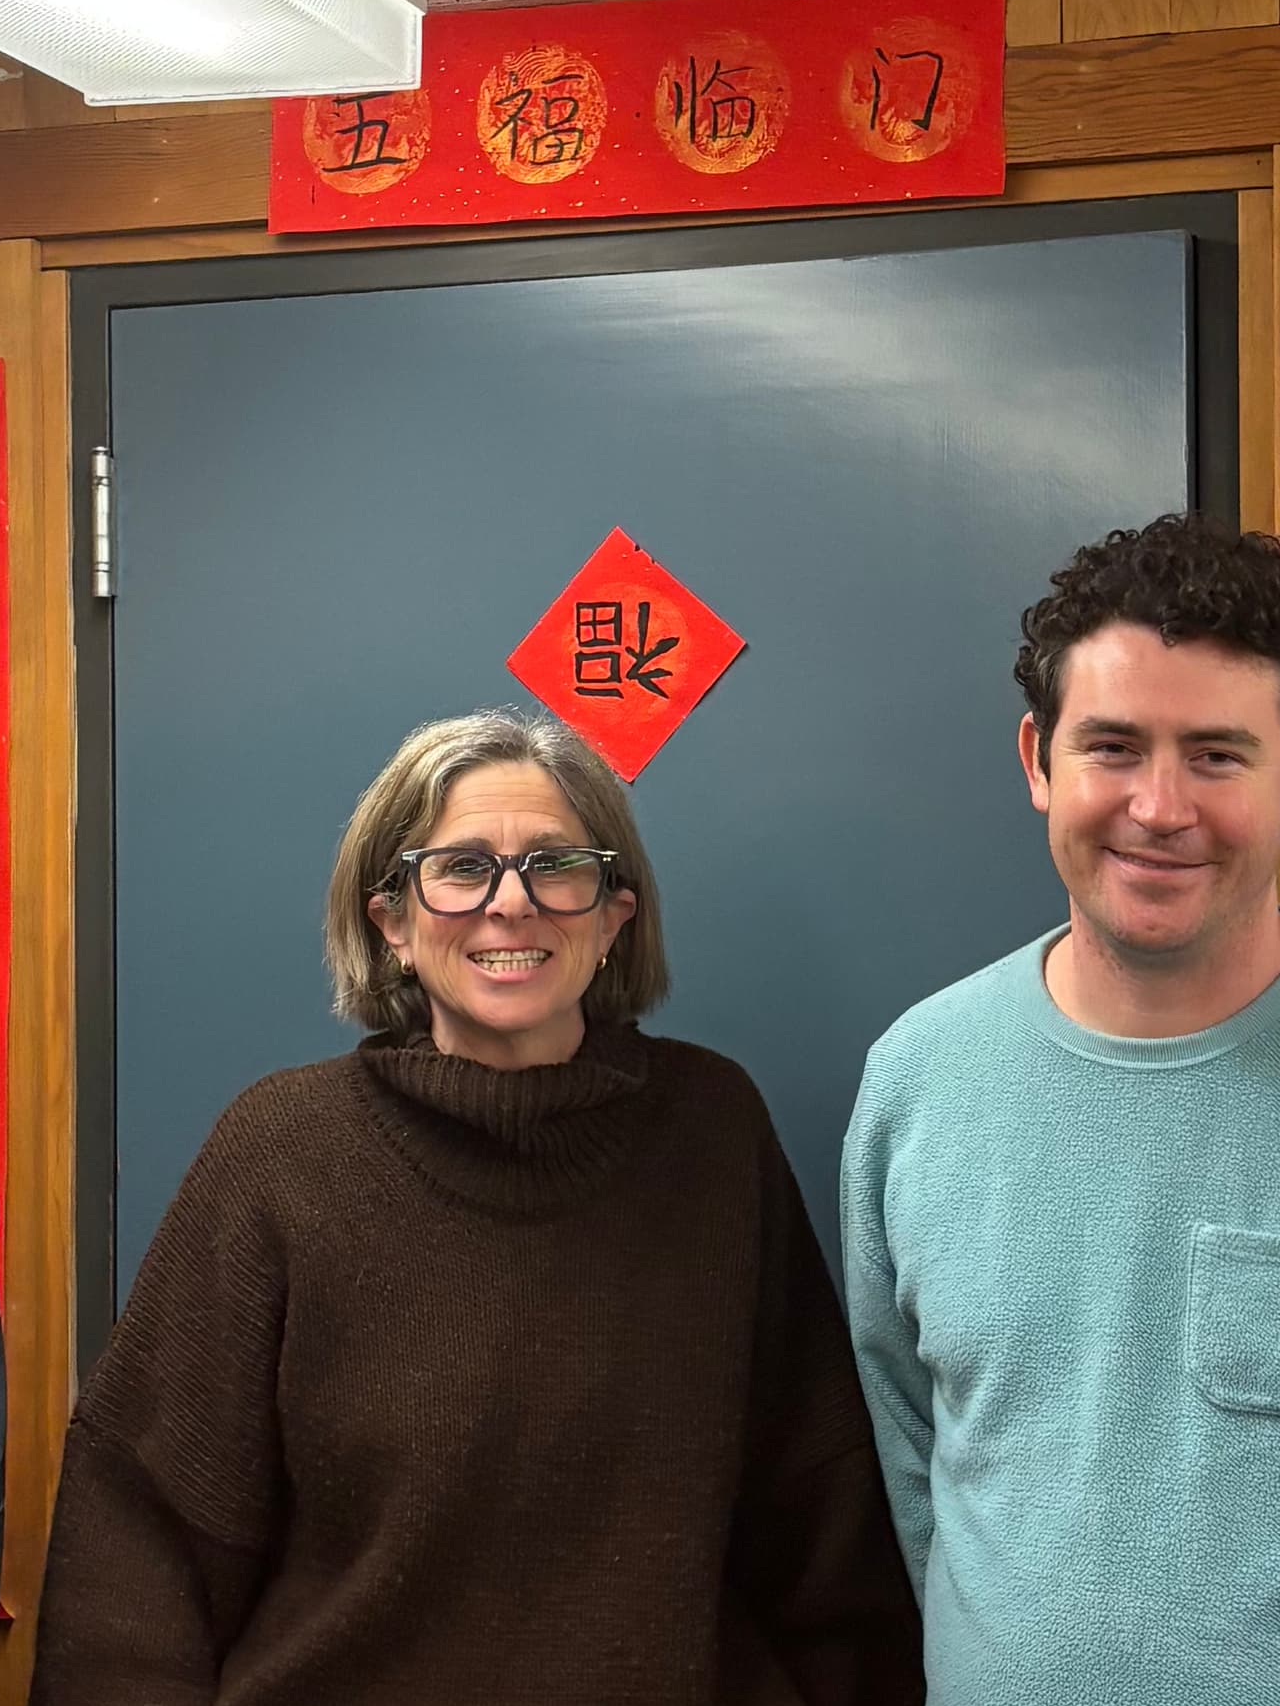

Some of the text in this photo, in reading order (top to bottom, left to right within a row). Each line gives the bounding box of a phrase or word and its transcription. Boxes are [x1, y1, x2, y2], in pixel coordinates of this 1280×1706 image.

[322, 46, 944, 173] 五福临门
[574, 601, 680, 699] 福
